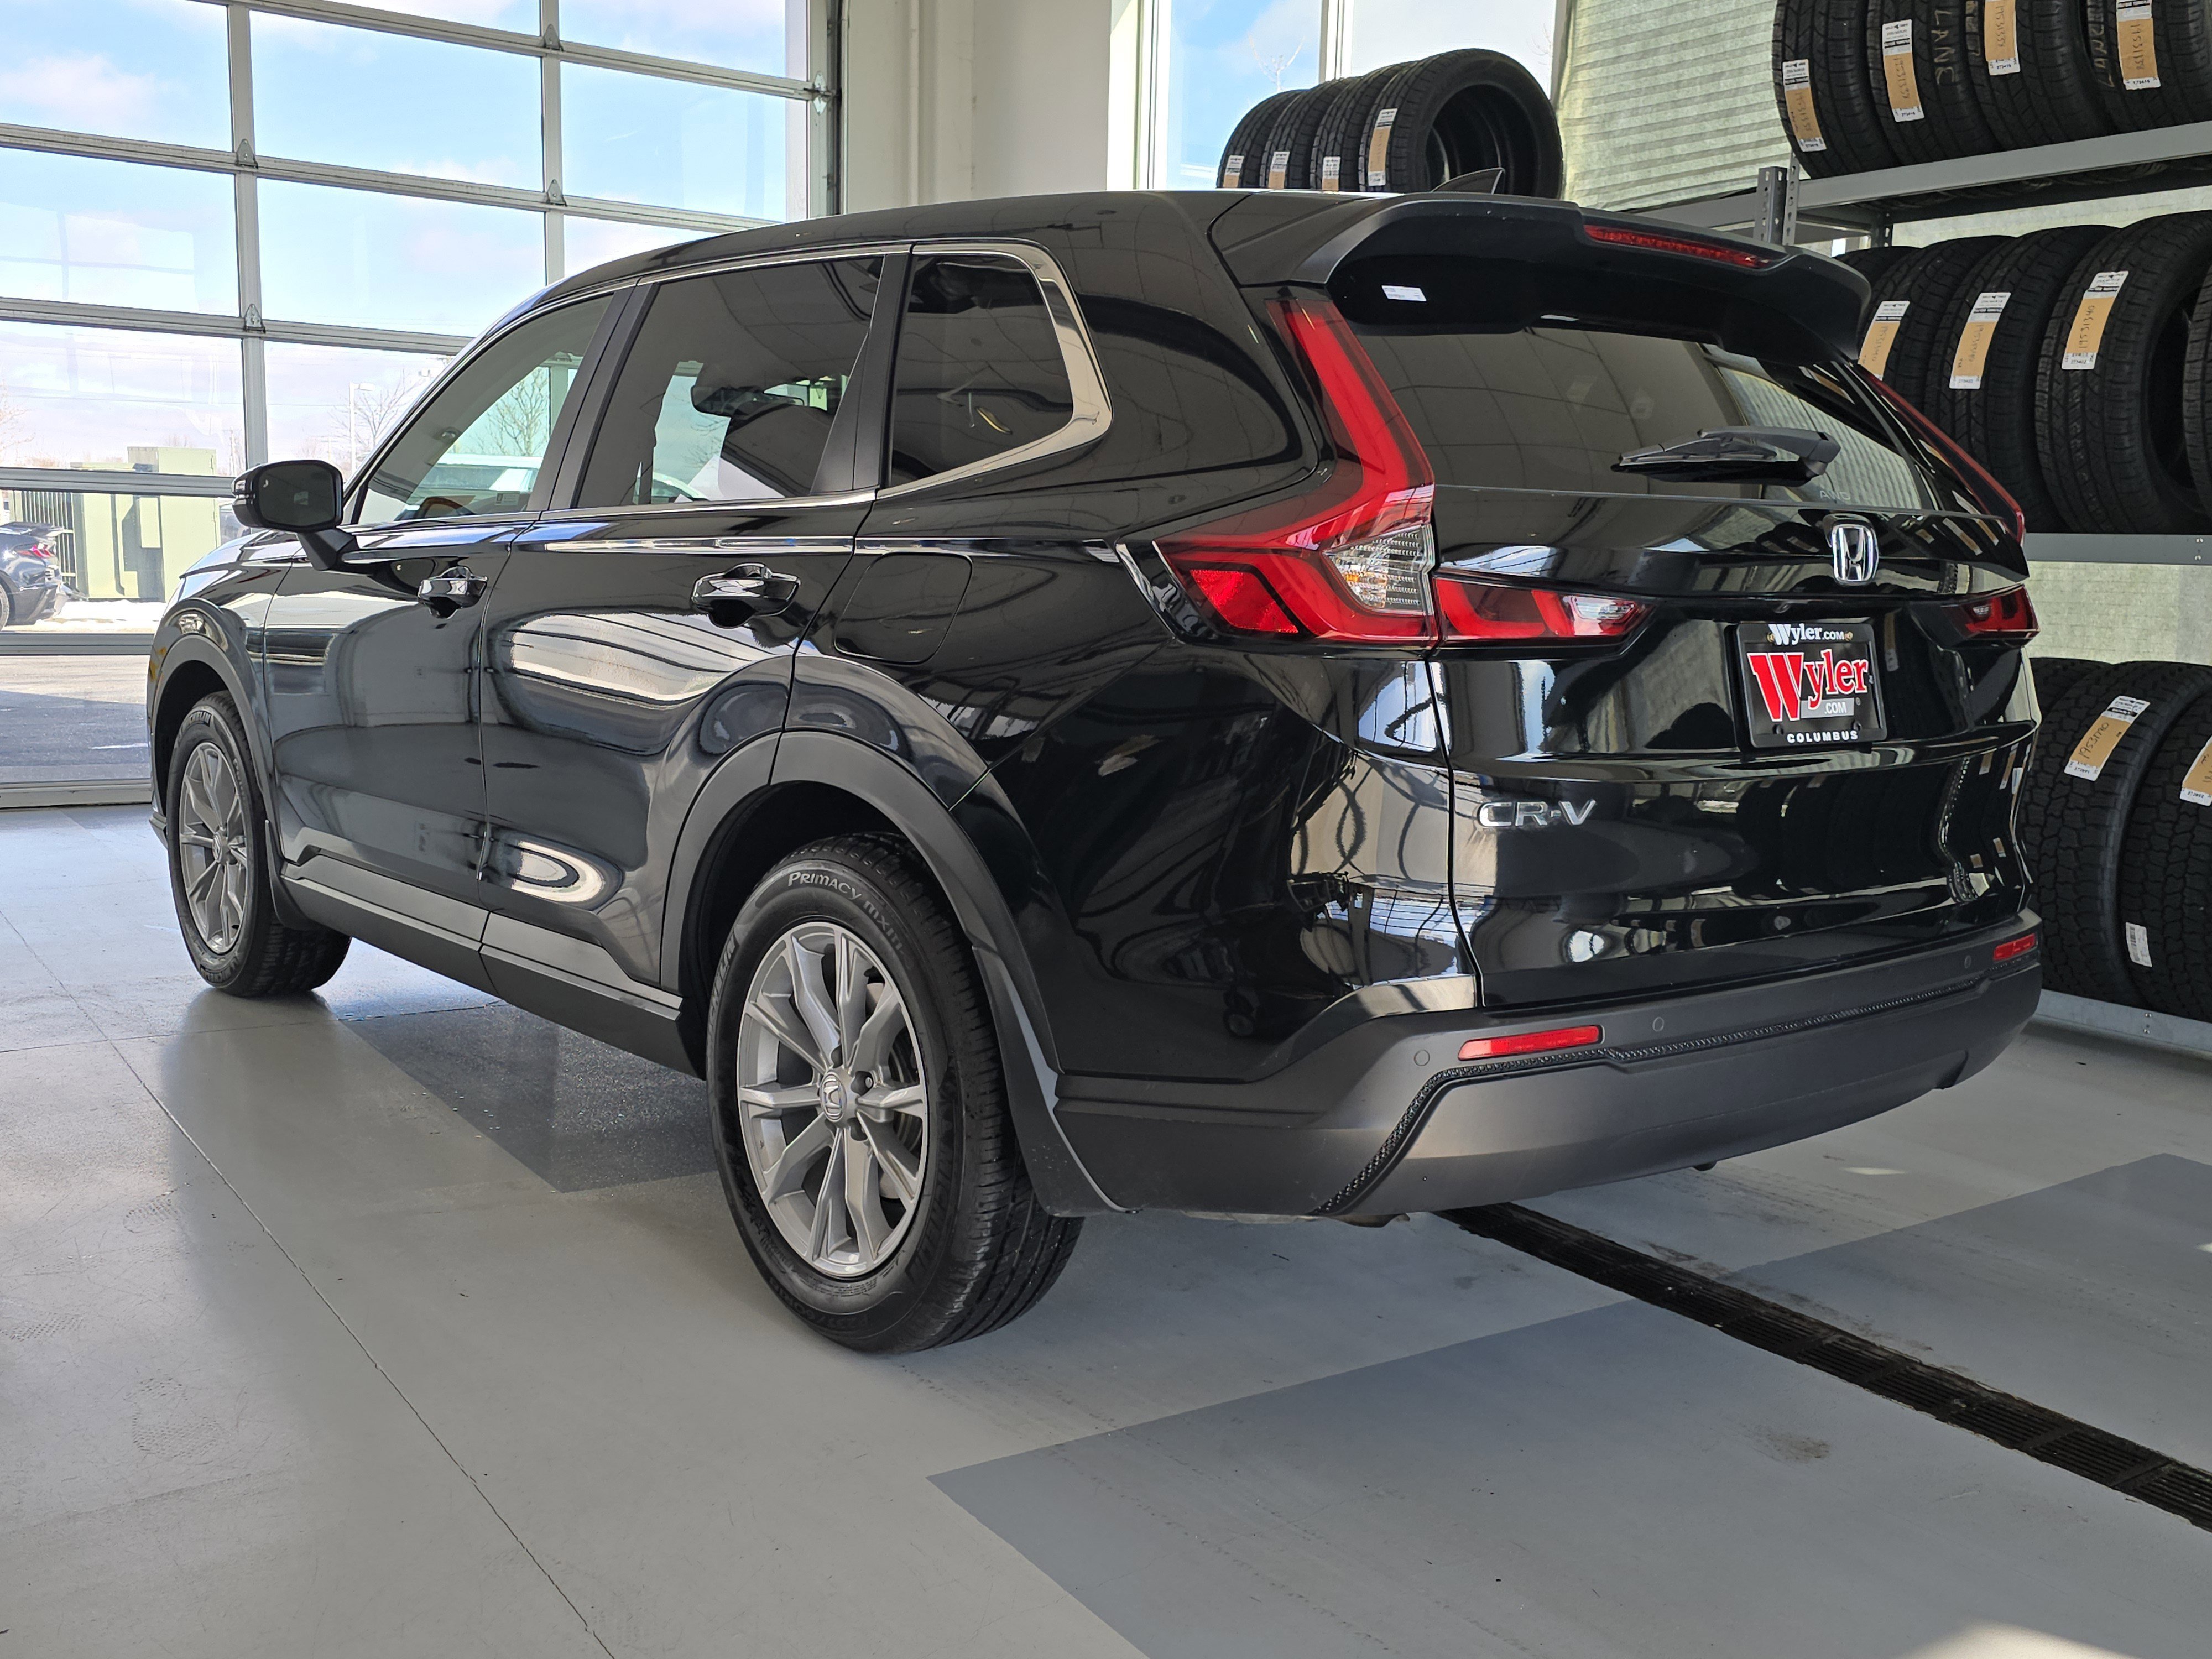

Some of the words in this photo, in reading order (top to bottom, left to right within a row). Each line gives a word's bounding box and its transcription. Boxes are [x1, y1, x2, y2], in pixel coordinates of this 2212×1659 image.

[1747, 649, 1869, 722] Wyler
[1787, 729, 1858, 744] COLUMBUS
[1477, 799, 1597, 827] CR-V
[788, 872, 862, 900] PRIMACY
